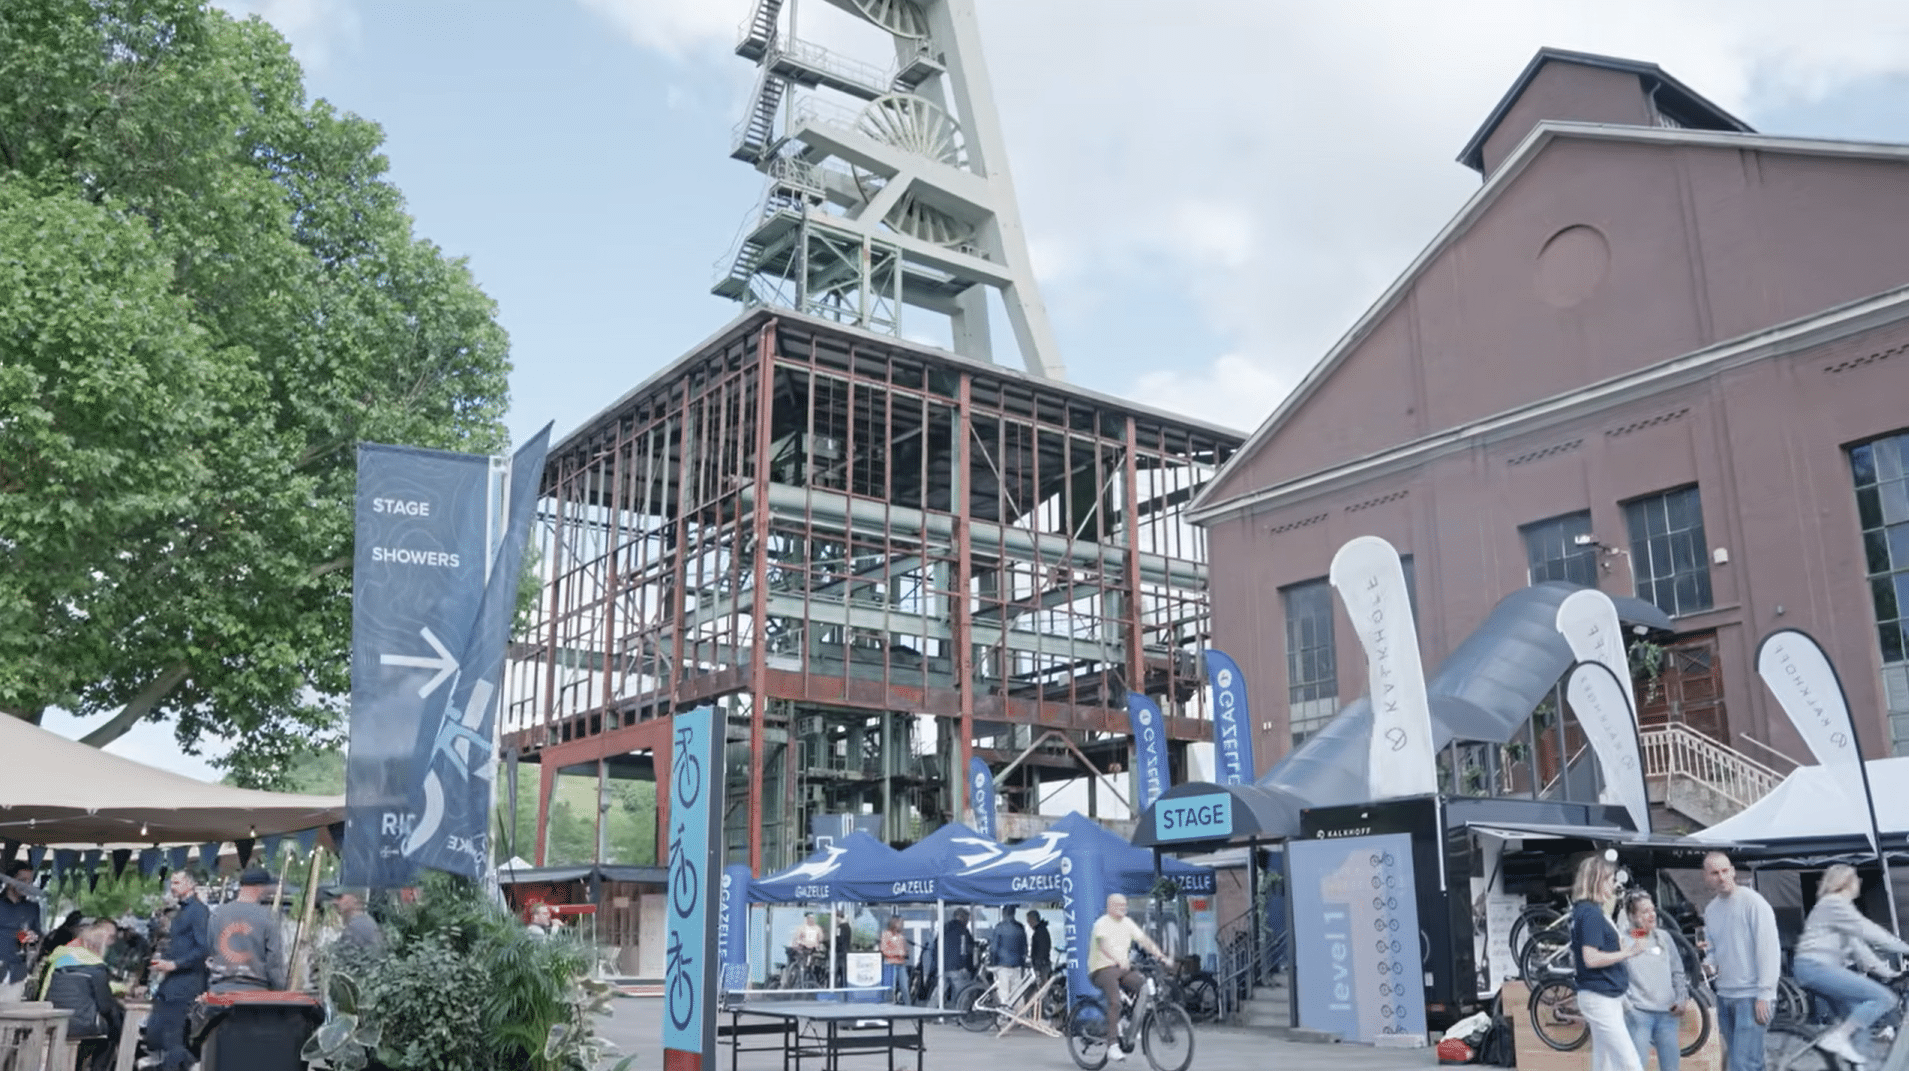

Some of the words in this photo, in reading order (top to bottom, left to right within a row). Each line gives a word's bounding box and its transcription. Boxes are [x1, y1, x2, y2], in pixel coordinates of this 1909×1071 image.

[372, 496, 430, 518] STAGE
[371, 545, 460, 569] SHOWERS
[1163, 803, 1224, 830] STAGE
[794, 884, 830, 899] GAZELLE
[892, 879, 935, 896] GAZELLE
[1011, 873, 1062, 892] GAZELLE
[1060, 876, 1079, 970] GAZELLE
[1323, 909, 1346, 925] 1
[1324, 931, 1352, 1011] level
